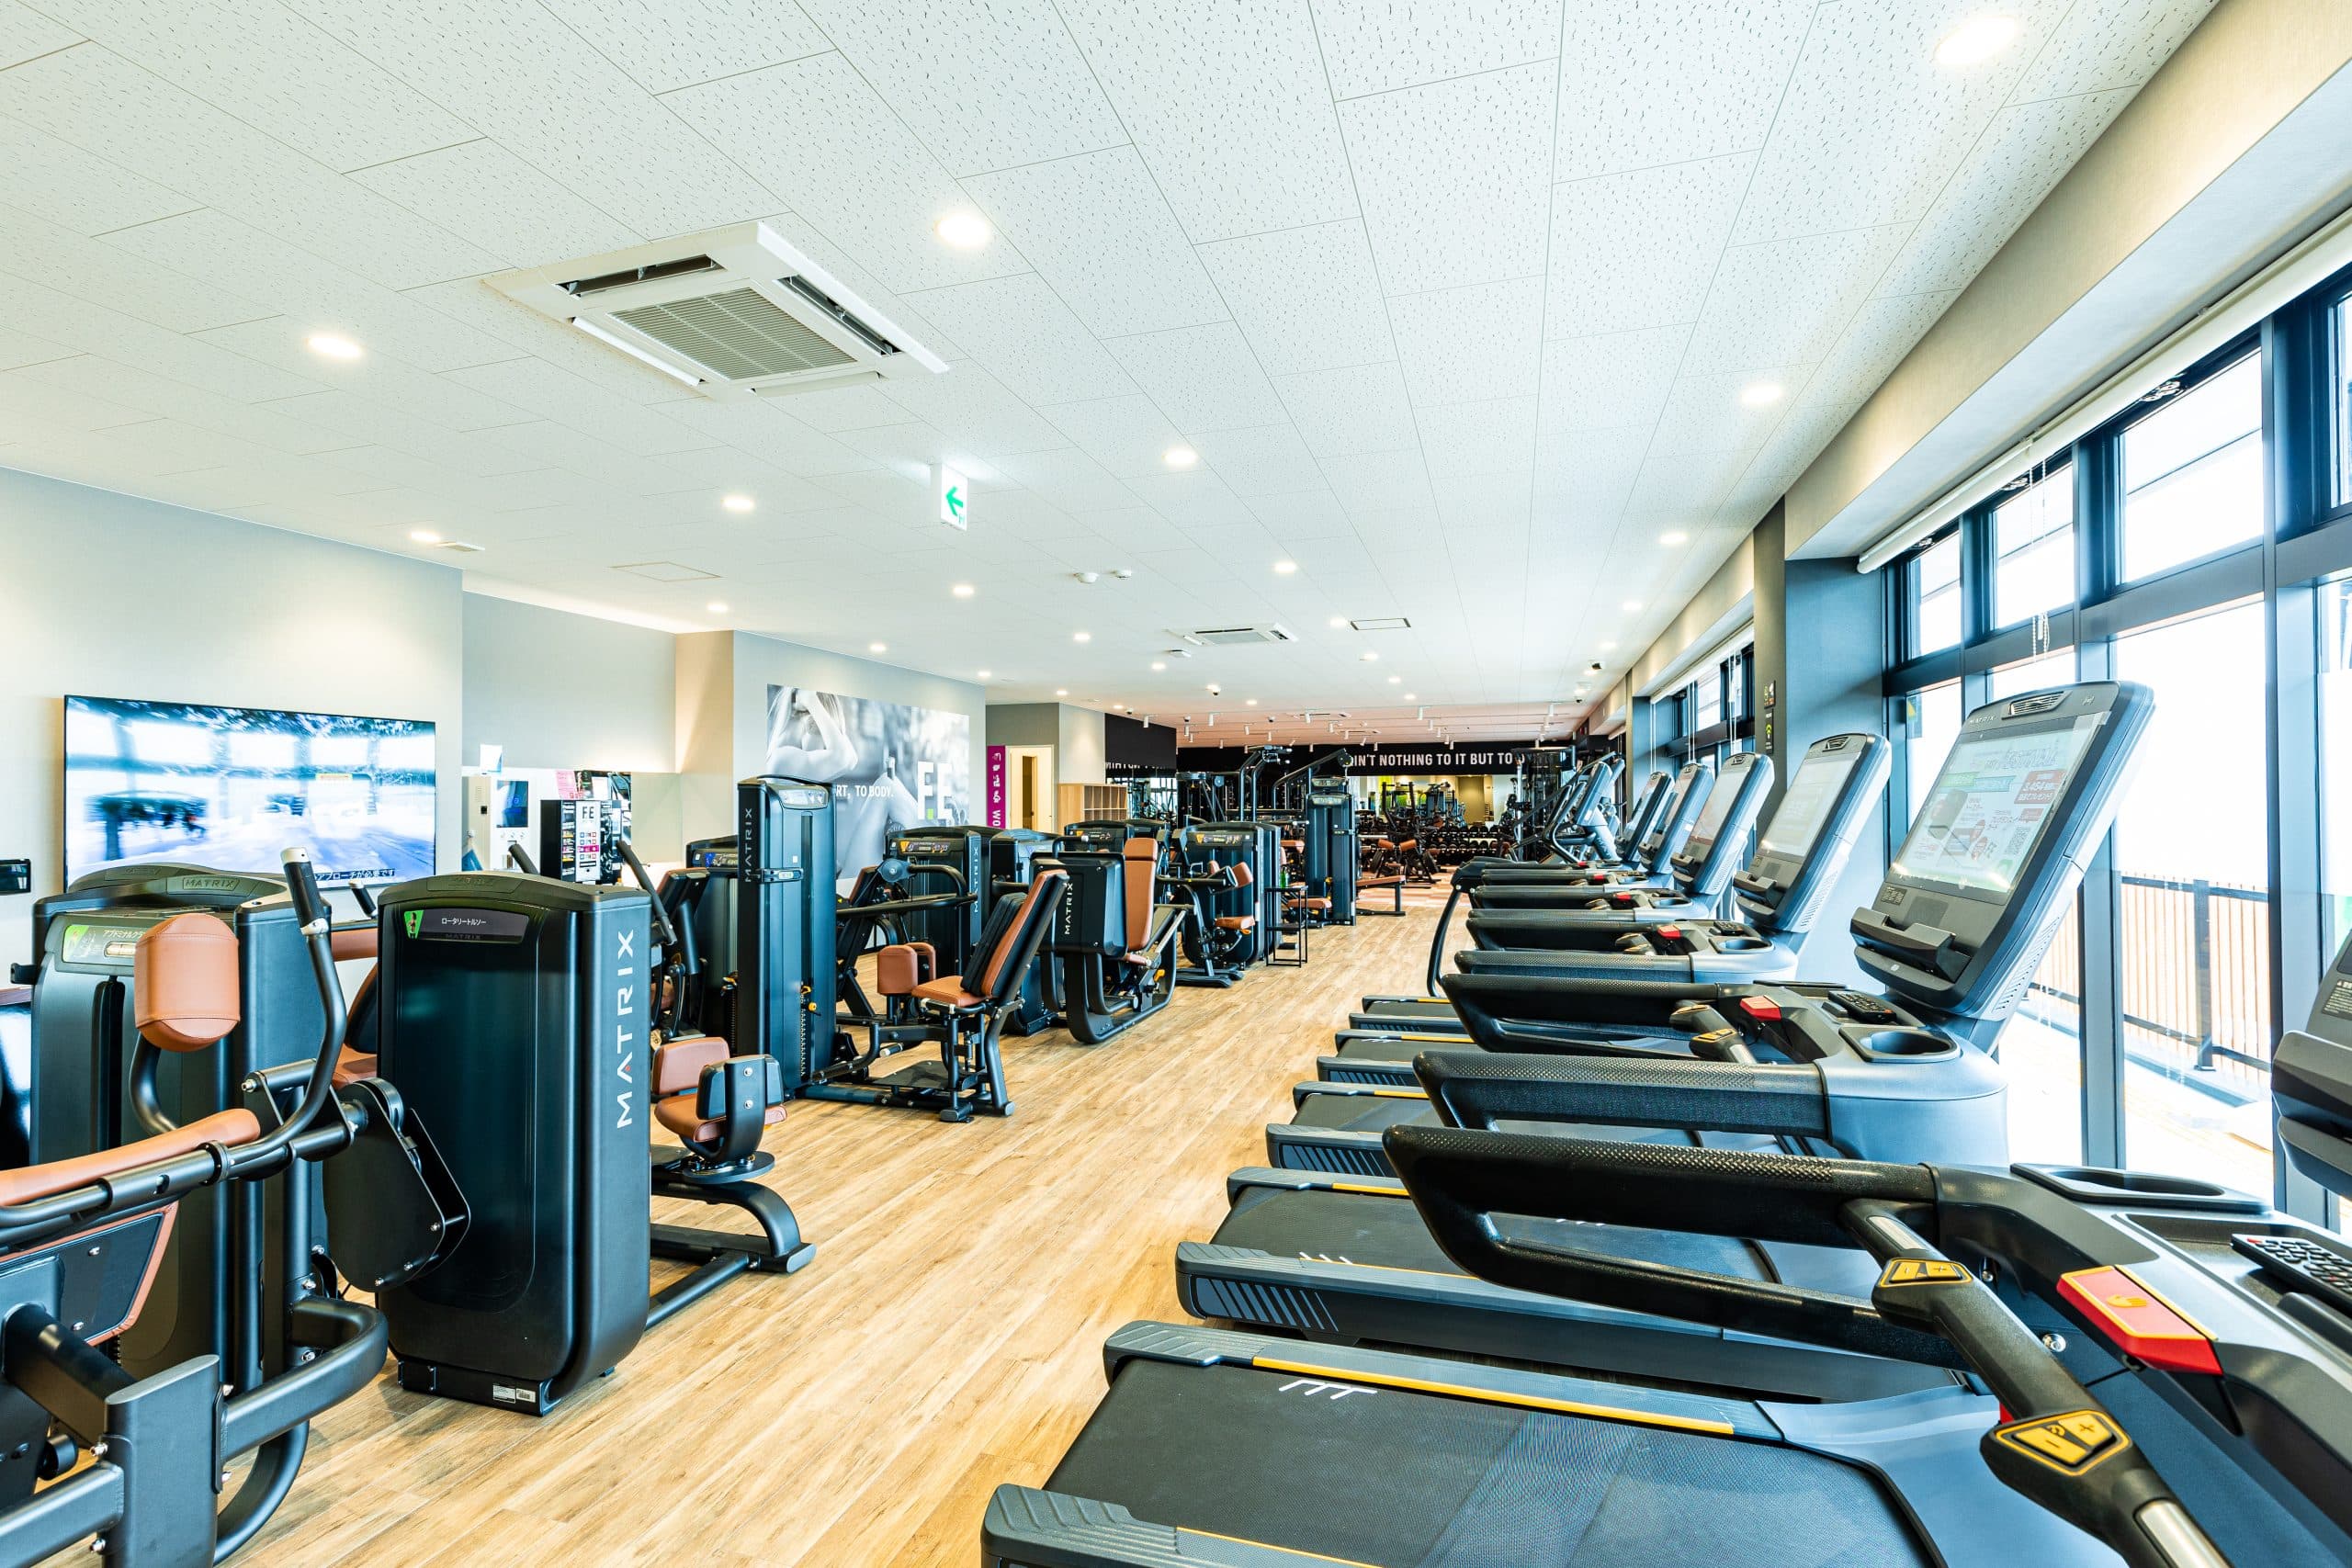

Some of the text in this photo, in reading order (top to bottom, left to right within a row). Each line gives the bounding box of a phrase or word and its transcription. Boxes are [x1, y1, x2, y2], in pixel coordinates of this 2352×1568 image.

[1351, 754, 1376, 766] IN'T
[1379, 753, 1433, 766] NOTHING
[1436, 753, 1452, 765] TO
[1455, 753, 1467, 765] IT
[1470, 752, 1494, 765] BUT
[1497, 752, 1513, 764] TO
[854, 784, 867, 797] TO
[868, 785, 894, 797] BODY.
[313, 869, 394, 881] アプローチが必要です
[185, 879, 235, 889] MATRIX
[1064, 883, 1073, 935] MATRIX
[441, 918, 487, 926] ロータリートルソー
[617, 930, 634, 1129] MATRIX
